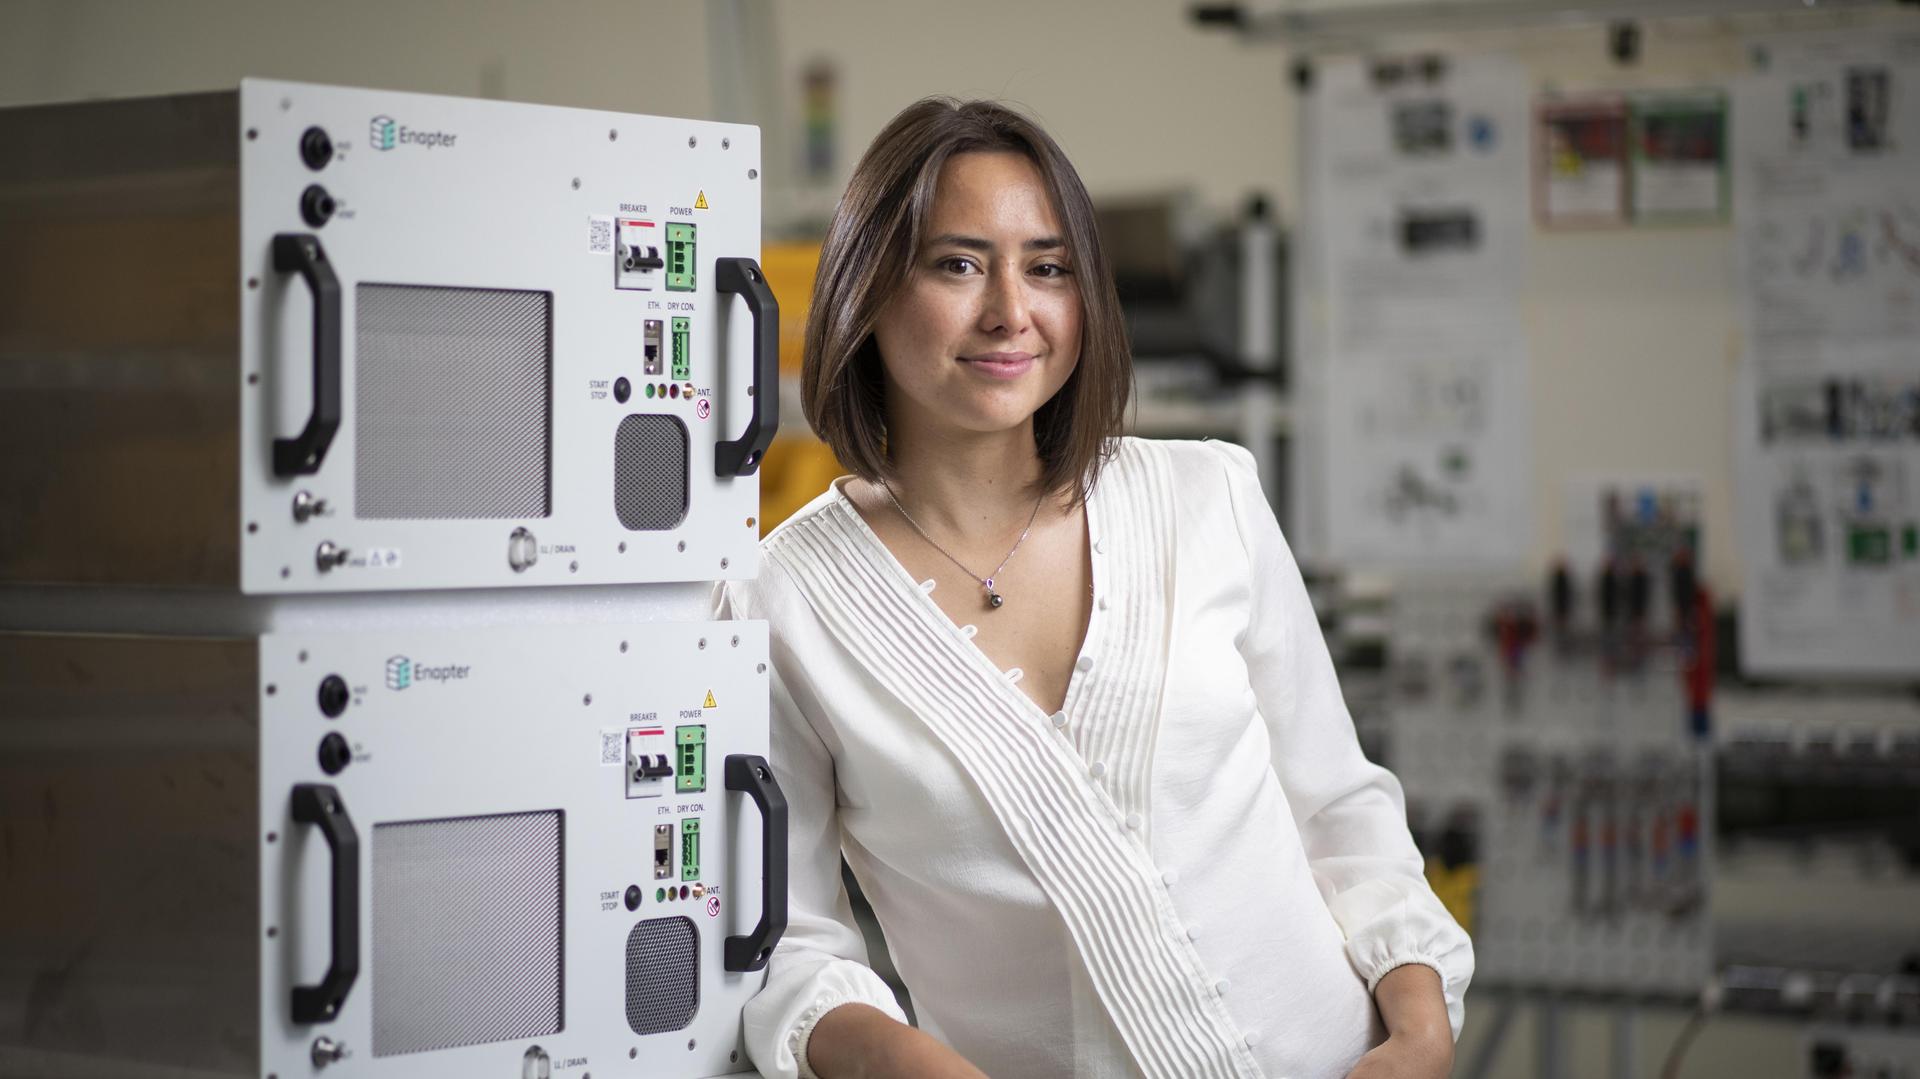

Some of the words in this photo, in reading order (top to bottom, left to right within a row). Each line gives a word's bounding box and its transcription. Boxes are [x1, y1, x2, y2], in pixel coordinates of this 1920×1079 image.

[399, 126, 457, 149] Enapter
[619, 203, 647, 213] BREAKER
[669, 206, 693, 216] POWER
[647, 301, 661, 310] ETH.
[667, 302, 680, 310] DRY
[681, 303, 696, 311] CON.
[589, 380, 609, 389] START
[590, 391, 608, 400] STOP
[696, 388, 712, 397] ANT.
[414, 663, 471, 684] Enapter
[630, 712, 657, 722] BREAKER
[679, 709, 702, 719] POWER
[657, 806, 671, 815] ETH.
[677, 804, 689, 813] DRY
[690, 803, 706, 813] CON.
[600, 890, 620, 901] START
[706, 886, 721, 896] ANT.
[601, 901, 618, 912] STOP
[567, 1057, 588, 1067] DRAIN
